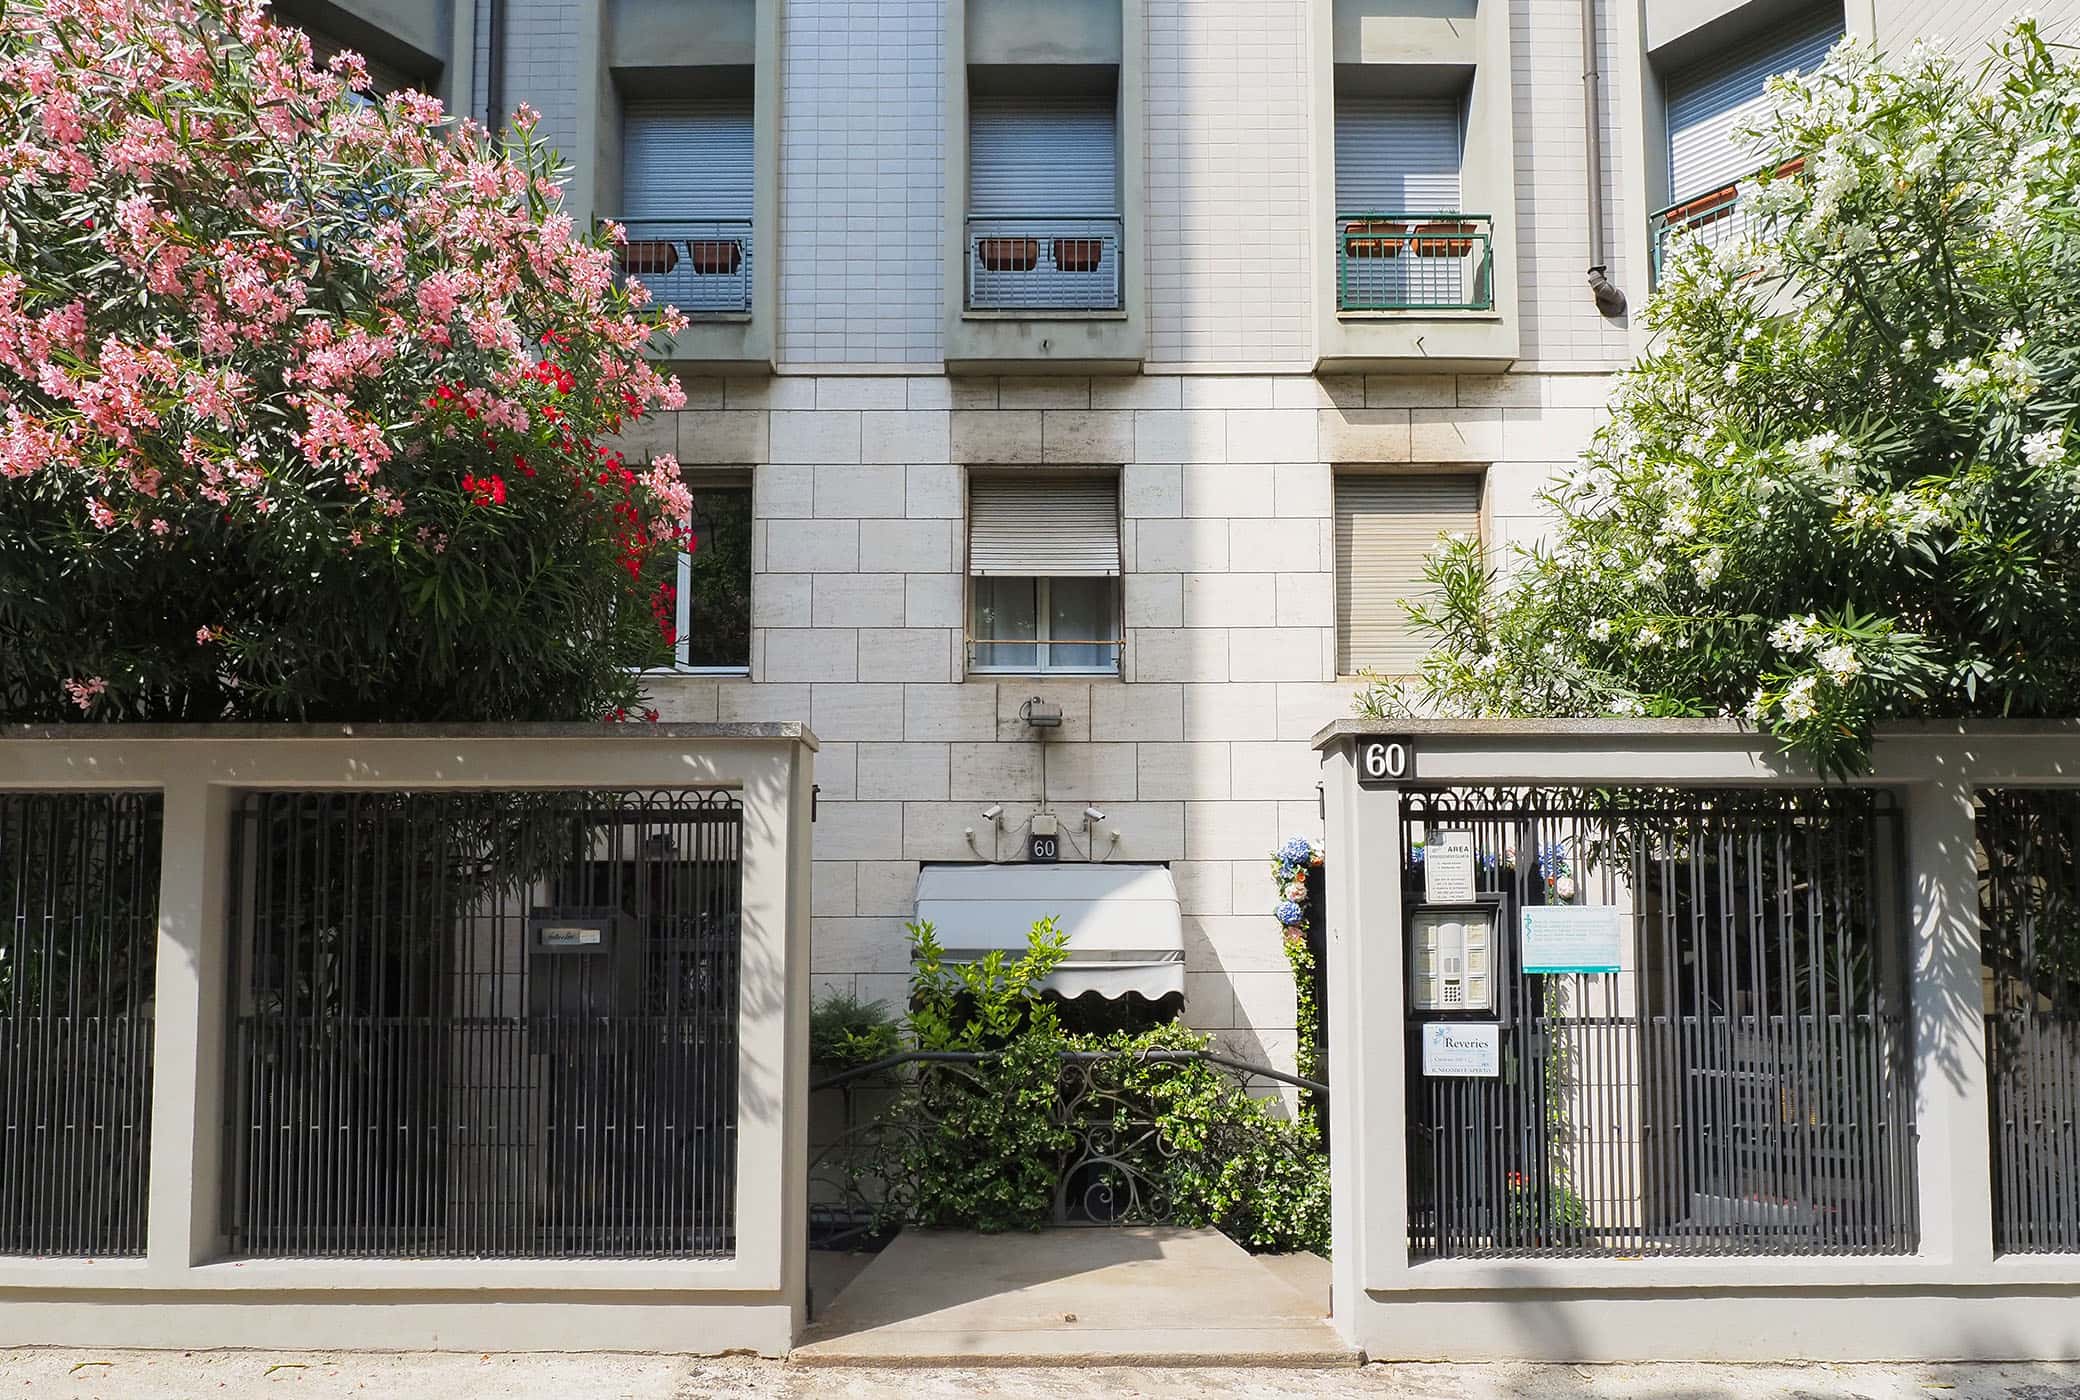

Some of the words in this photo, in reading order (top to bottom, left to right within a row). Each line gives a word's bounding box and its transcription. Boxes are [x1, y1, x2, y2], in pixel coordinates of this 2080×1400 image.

[1366, 744, 1405, 776] 60
[1034, 840, 1054, 856] 60
[1445, 1036, 1489, 1049] Reveries
